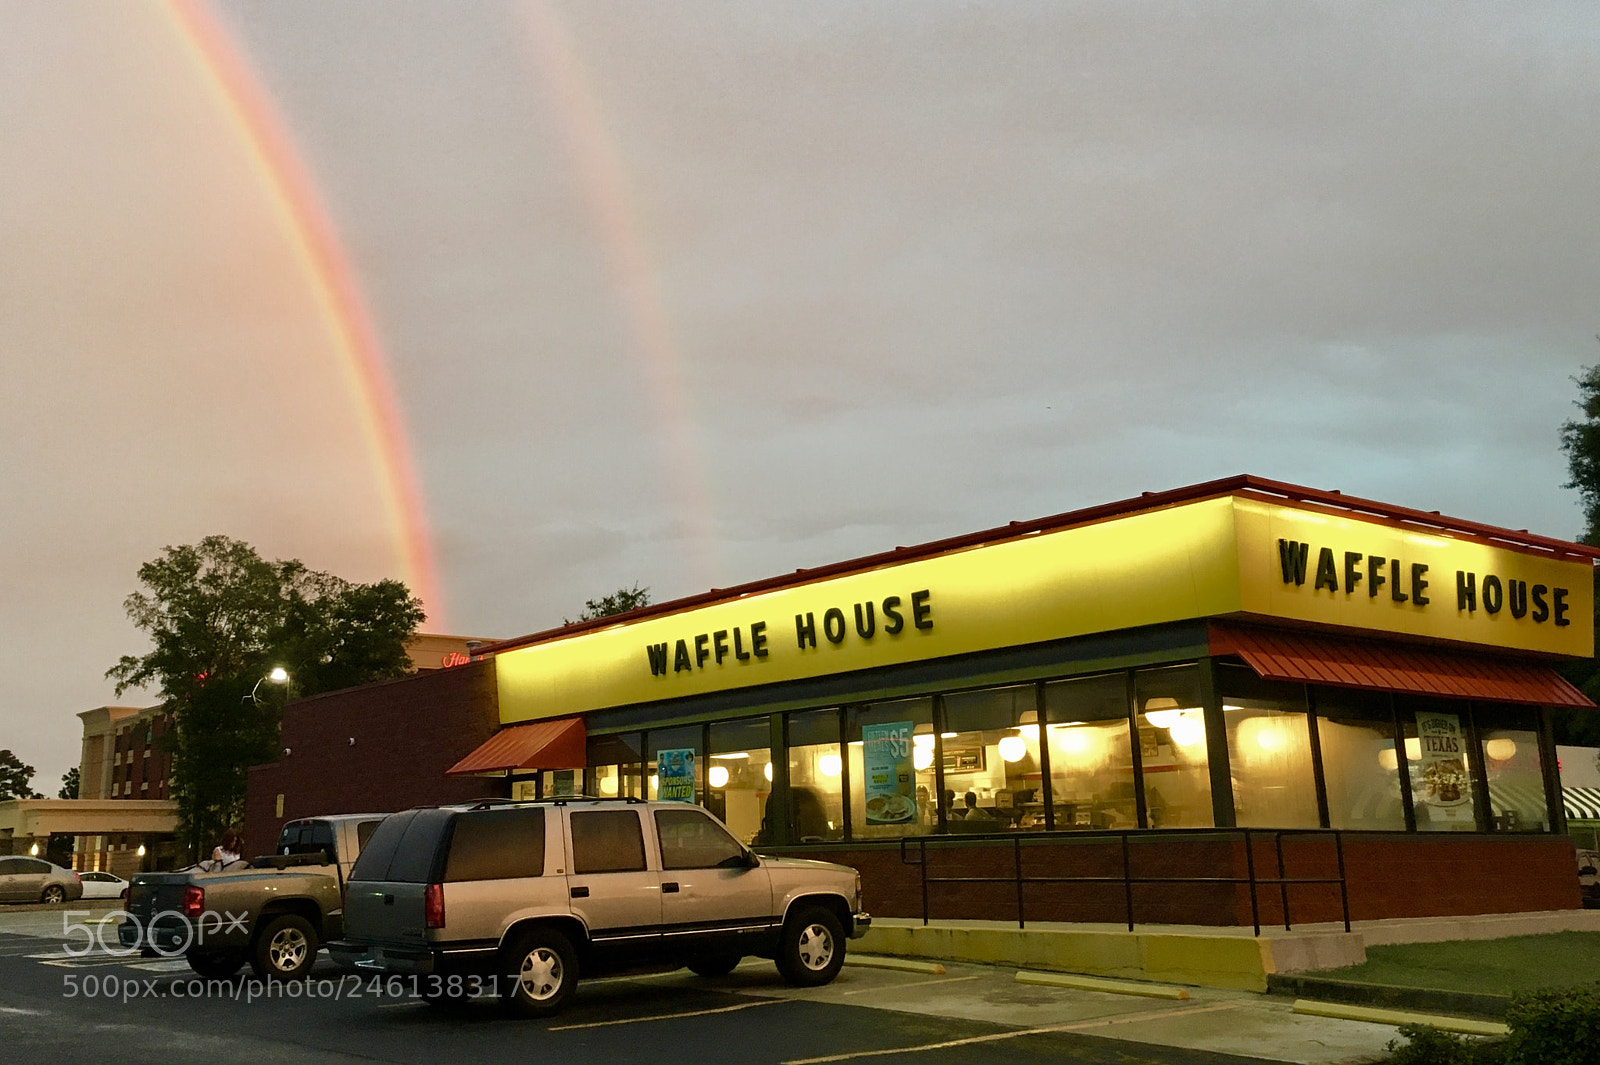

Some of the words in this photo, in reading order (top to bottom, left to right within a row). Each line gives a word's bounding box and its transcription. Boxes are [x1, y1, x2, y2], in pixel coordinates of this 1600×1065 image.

[1279, 539, 1429, 605] WAFFLE
[1456, 571, 1570, 626] HOUSE
[646, 621, 768, 676] WAFFLE
[795, 589, 934, 649] HOUSE
[890, 728, 909, 758] $5
[1423, 735, 1459, 752] TEXAS
[662, 785, 693, 799] WANTED
